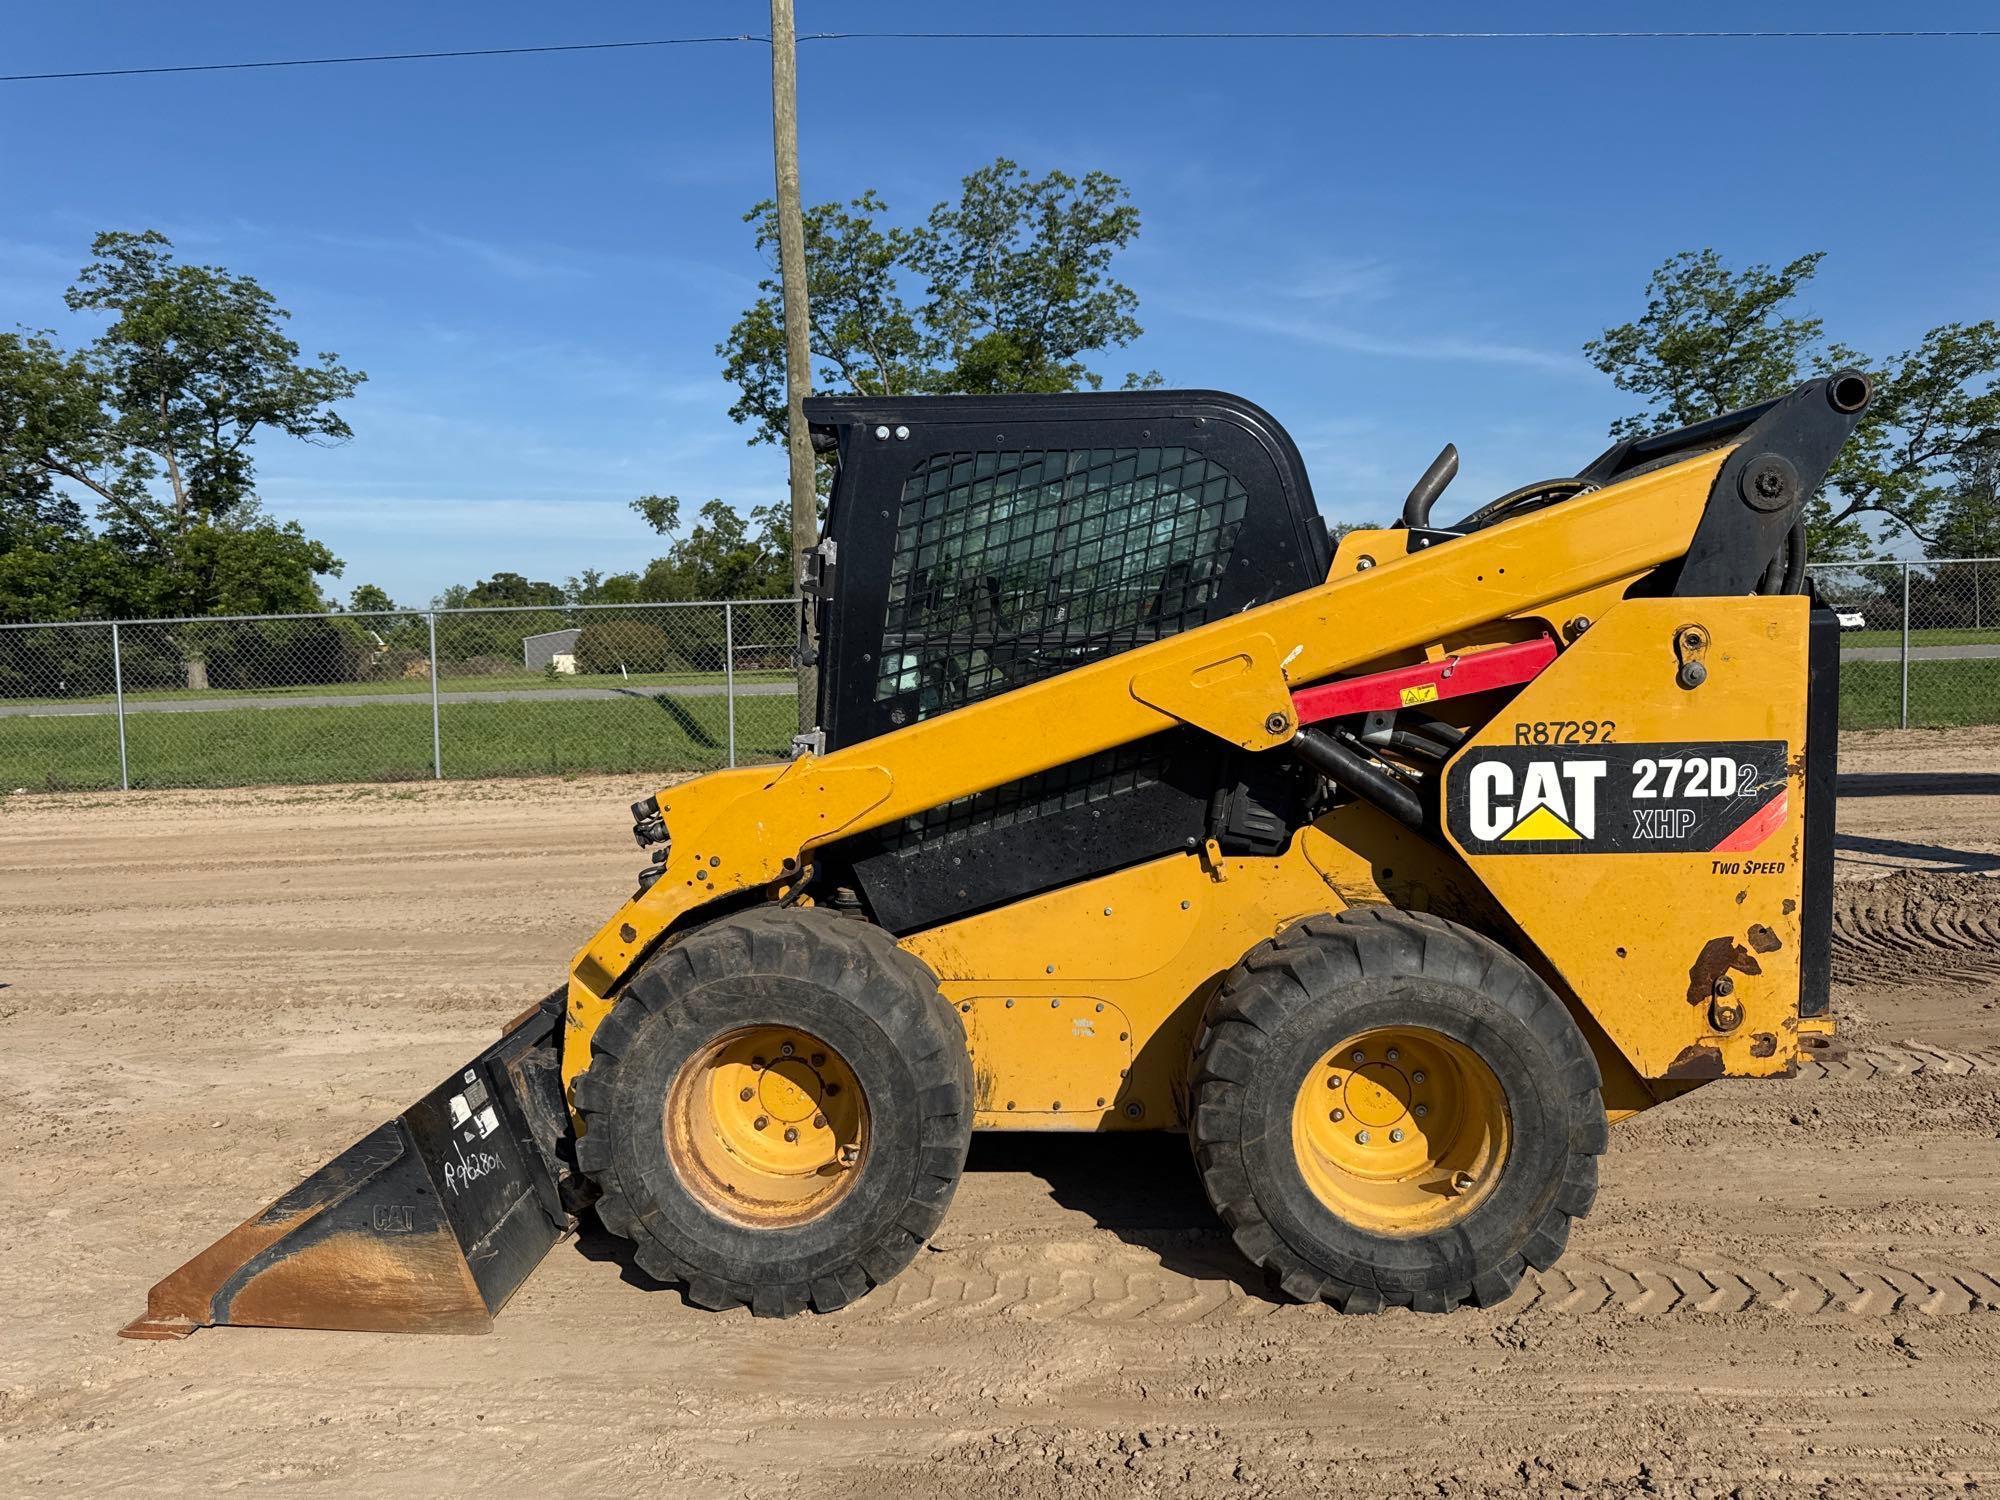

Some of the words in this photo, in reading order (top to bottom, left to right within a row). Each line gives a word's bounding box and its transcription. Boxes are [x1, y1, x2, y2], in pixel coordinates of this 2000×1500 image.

[1515, 720, 1616, 745] R87292
[1469, 760, 1607, 841] CAT
[1632, 809, 1696, 839] XHP
[373, 1204, 416, 1232] CAT
